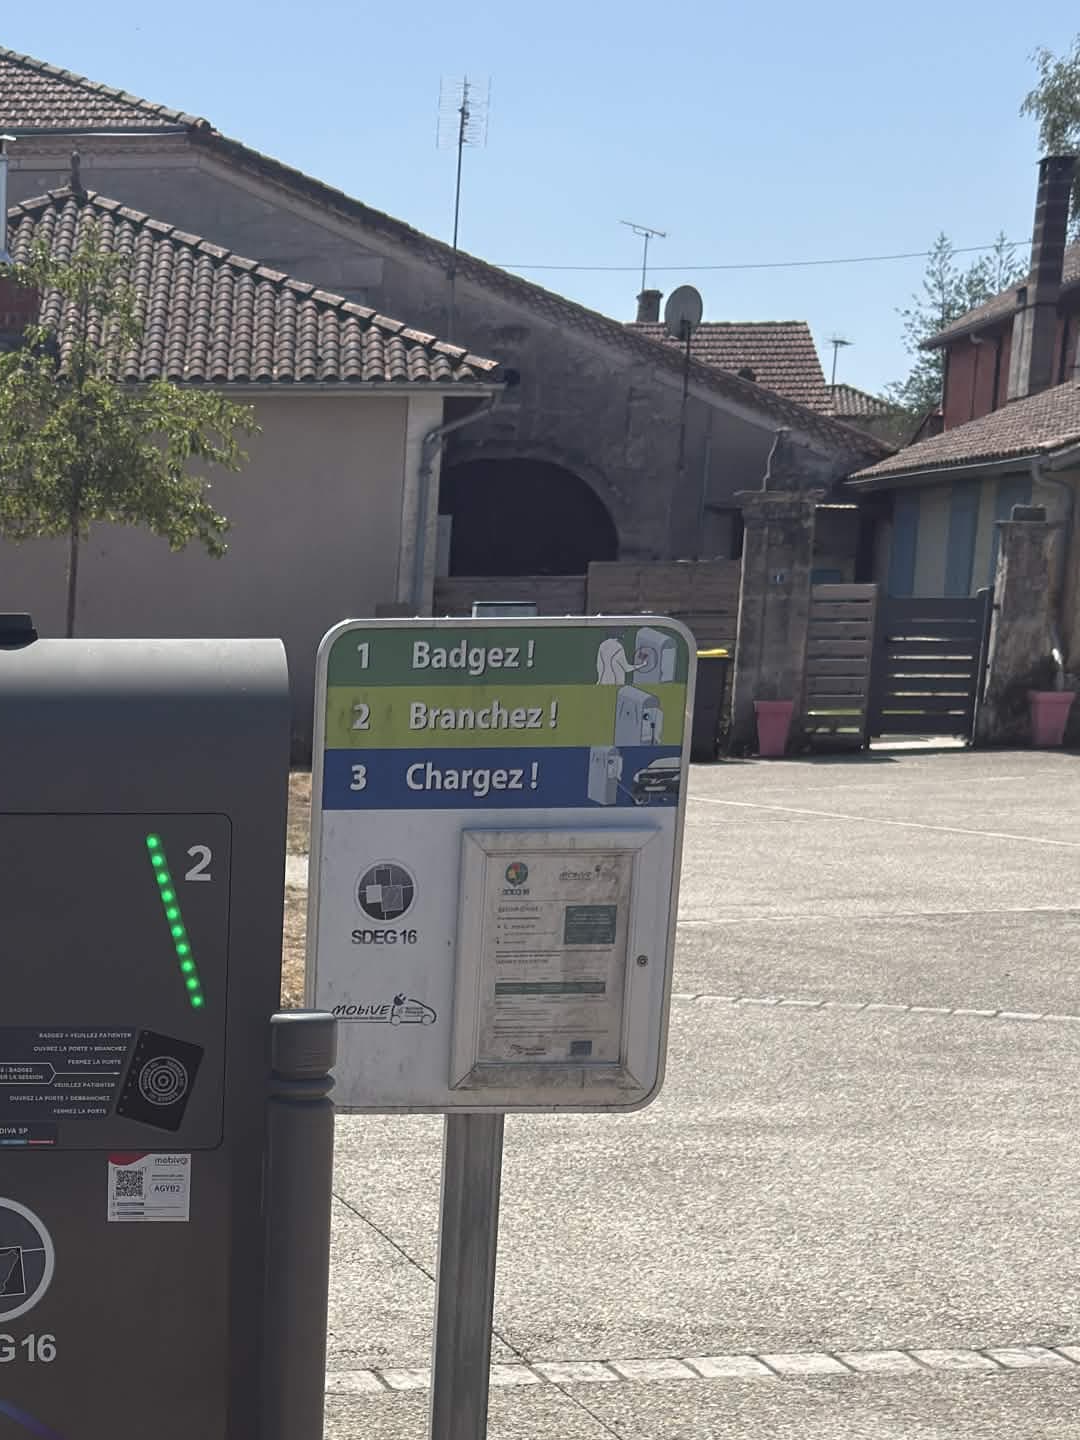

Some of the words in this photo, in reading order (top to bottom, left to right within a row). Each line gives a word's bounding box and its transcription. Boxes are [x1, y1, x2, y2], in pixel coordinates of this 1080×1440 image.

[357, 642, 370, 669] 1
[412, 639, 520, 676] Badgez
[351, 703, 370, 730] 2
[409, 699, 544, 730] Branchez
[350, 764, 367, 791] 3
[406, 762, 525, 797] Chargez
[184, 845, 212, 881] 2
[351, 929, 398, 945] SDEG
[399, 929, 418, 945] 16
[0, 1127, 16, 1135] DIVA
[21, 1334, 57, 1363] 16
